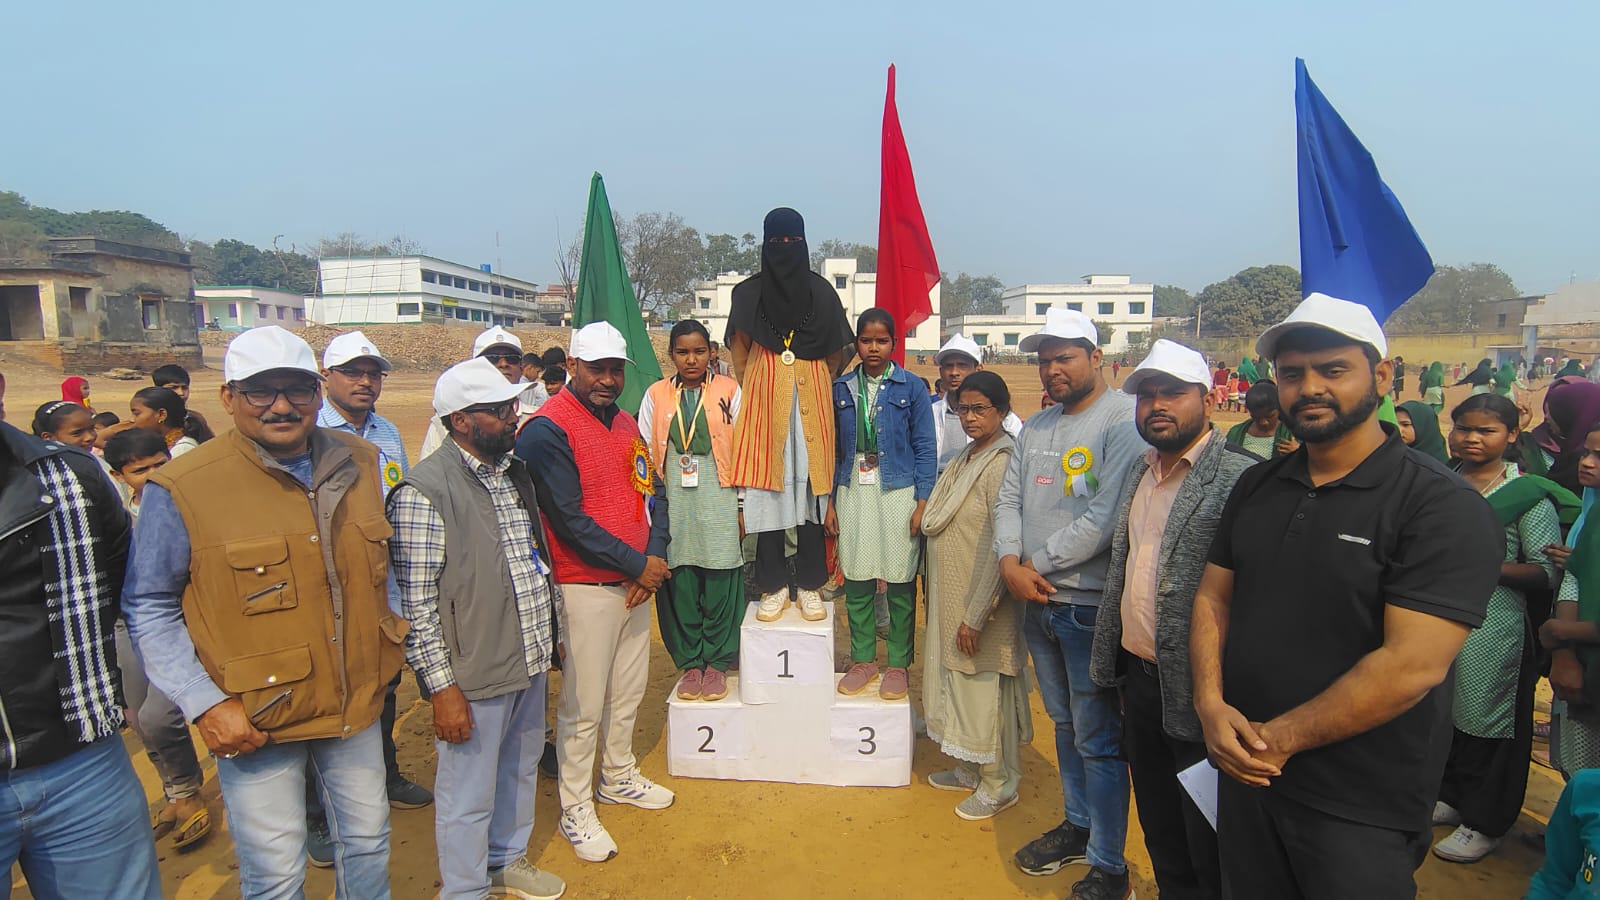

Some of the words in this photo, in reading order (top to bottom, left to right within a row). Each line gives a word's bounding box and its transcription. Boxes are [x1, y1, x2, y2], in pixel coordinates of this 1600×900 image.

[777, 649, 794, 678] 1
[696, 725, 716, 753] 2
[857, 726, 877, 755] 3
